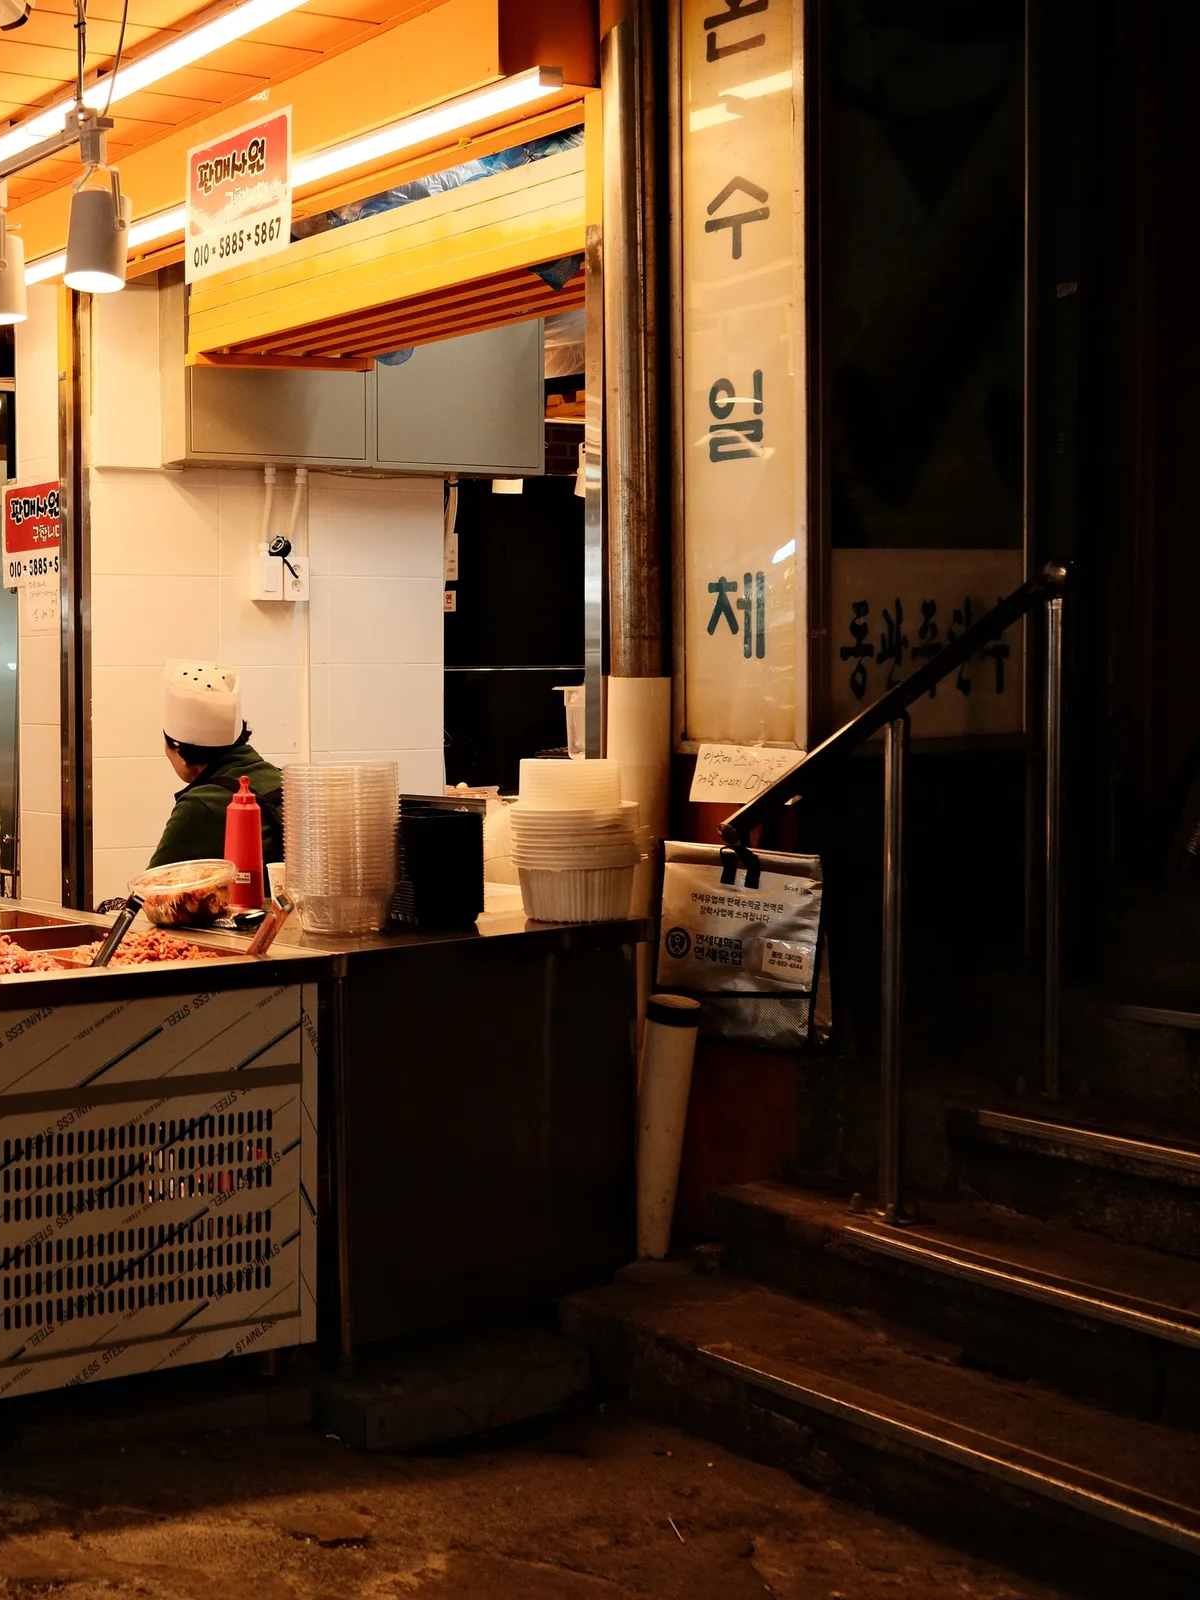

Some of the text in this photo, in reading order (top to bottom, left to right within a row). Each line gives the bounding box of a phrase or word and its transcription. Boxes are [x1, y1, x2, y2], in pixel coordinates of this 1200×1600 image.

[196, 137, 267, 194] 판매사원
[695, 933, 743, 950] 연세대학교
[693, 946, 743, 965] 연세유업
[163, 1006, 190, 1027] STEEL
